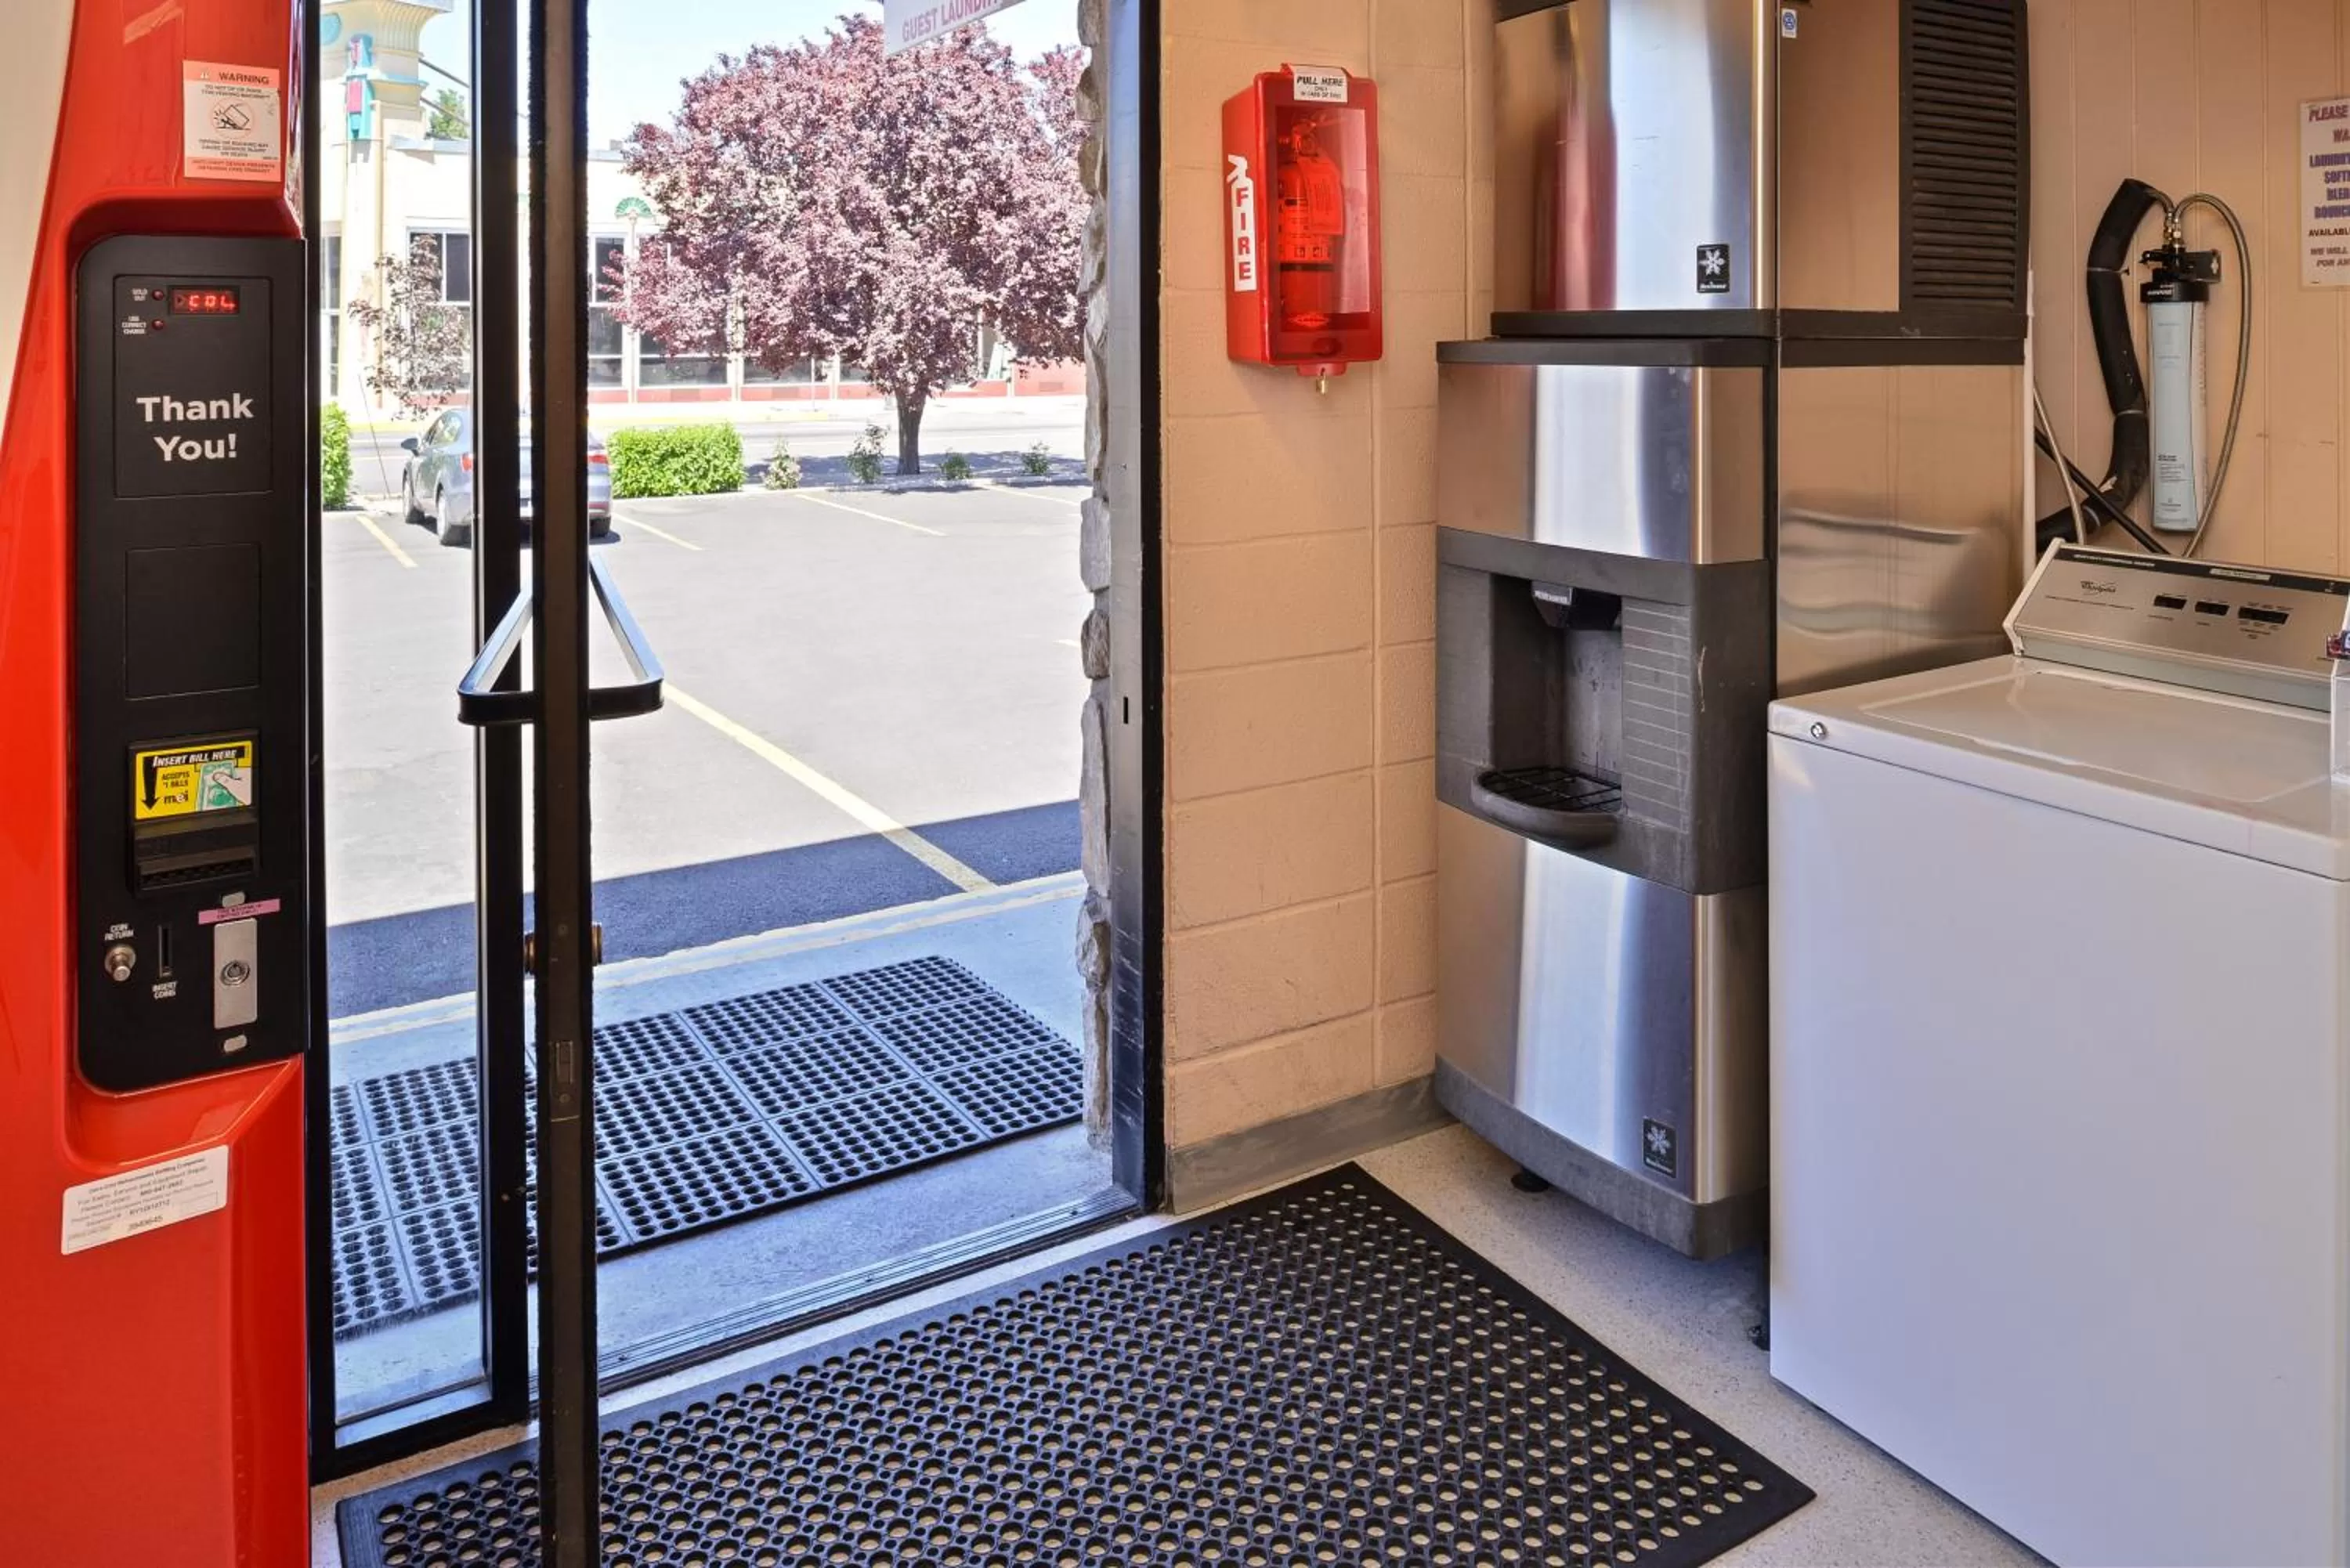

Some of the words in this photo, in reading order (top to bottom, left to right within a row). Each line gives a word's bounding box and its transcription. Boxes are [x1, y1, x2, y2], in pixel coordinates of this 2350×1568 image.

[902, 7, 938, 42] GUEST
[941, 0, 996, 25] LAUND
[219, 71, 269, 85] WARNING
[1297, 75, 1318, 85] PULL
[2309, 105, 2348, 121] PLEASE
[1235, 187, 1251, 280] FIRE
[2308, 226, 2350, 237] AVAILABL
[136, 392, 254, 423] Thank
[154, 433, 237, 462] You!
[152, 756, 188, 768] INSERT
[189, 752, 209, 764] BILL
[212, 750, 237, 761] HERE
[104, 930, 134, 941] RETURN
